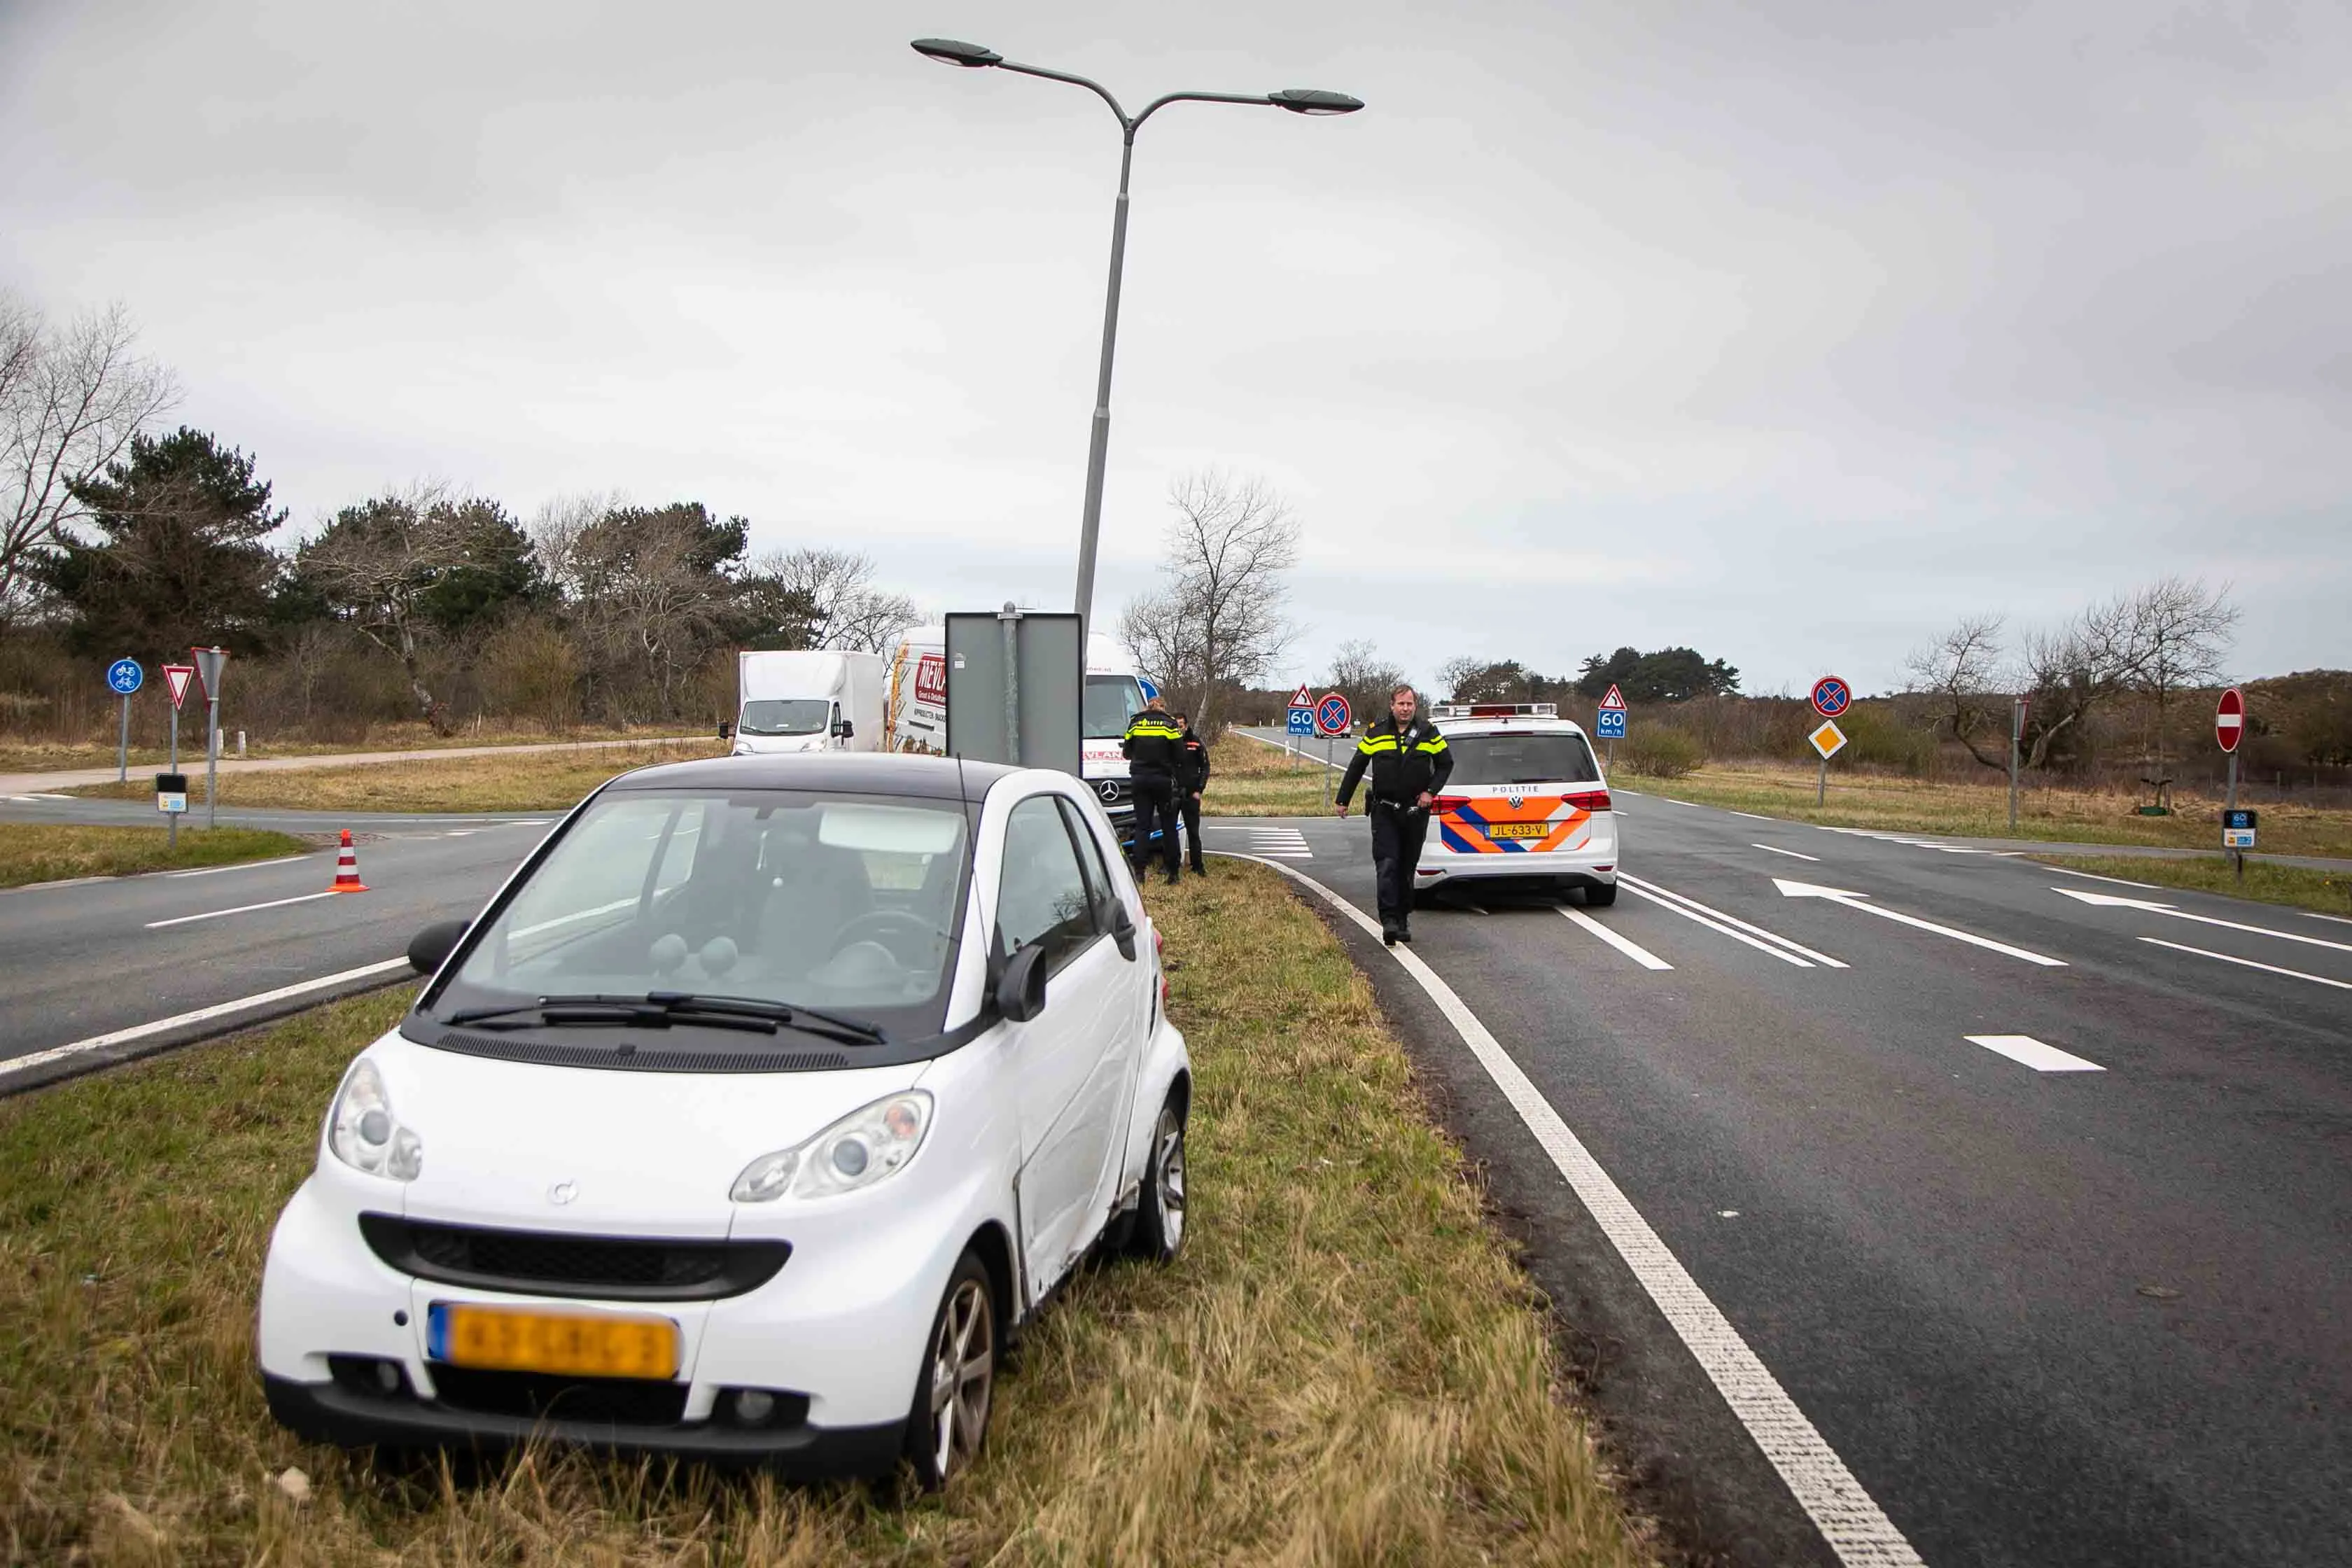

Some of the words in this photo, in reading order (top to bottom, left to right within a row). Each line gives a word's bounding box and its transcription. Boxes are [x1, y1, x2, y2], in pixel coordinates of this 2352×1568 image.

[1291, 711, 1312, 724] 60
[1601, 713, 1623, 726] 60
[1495, 825, 1542, 836] JL-633-V
